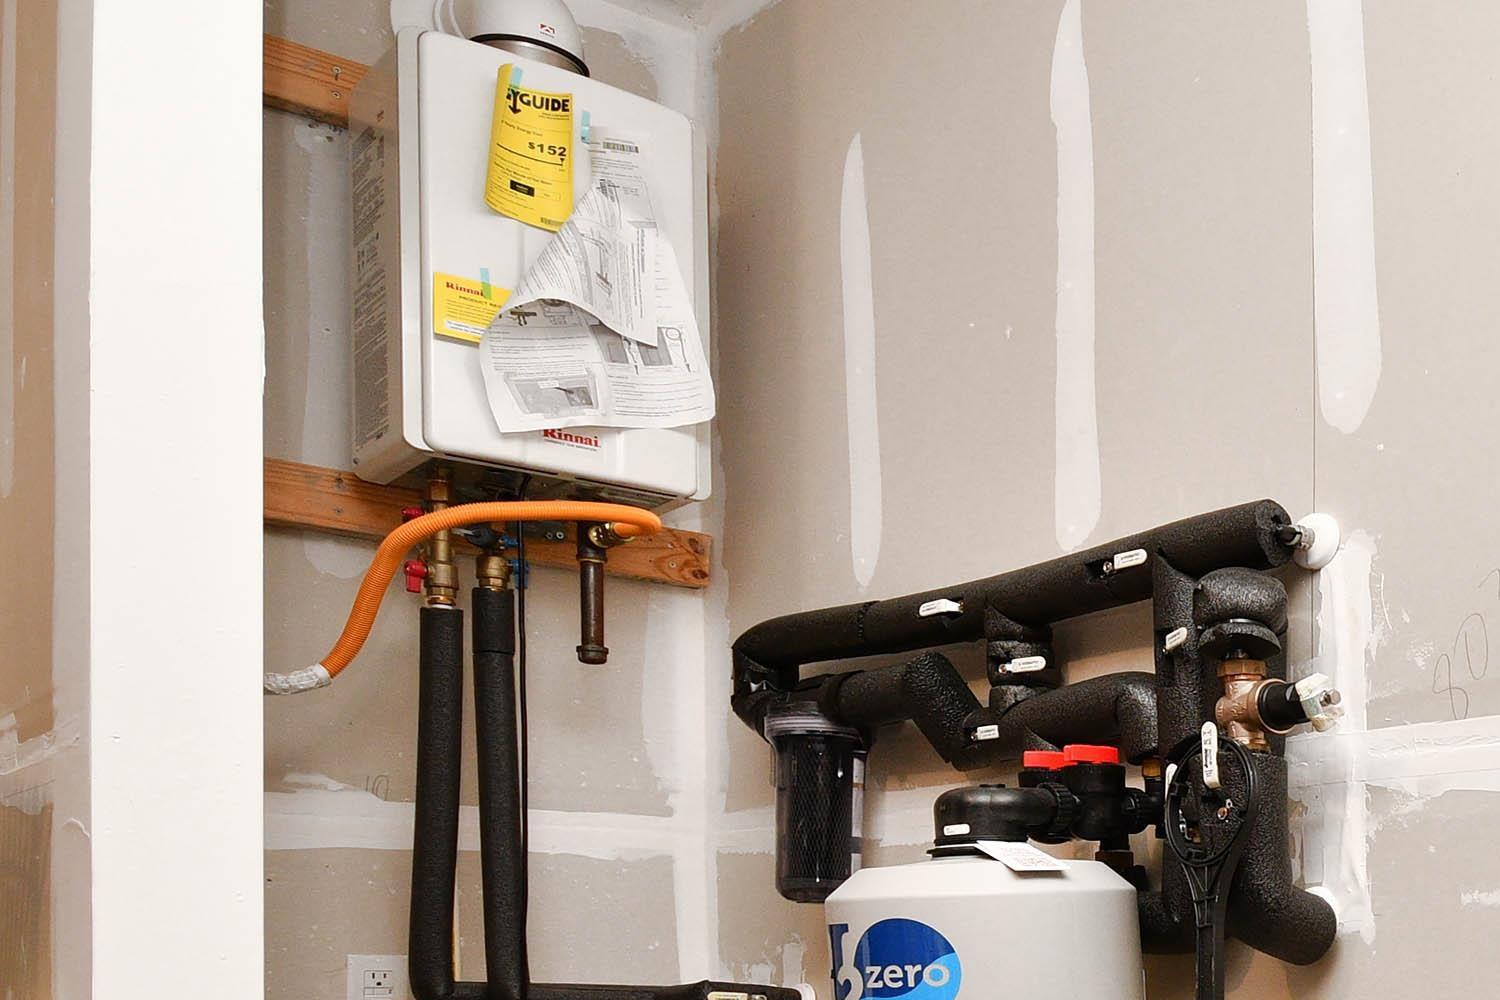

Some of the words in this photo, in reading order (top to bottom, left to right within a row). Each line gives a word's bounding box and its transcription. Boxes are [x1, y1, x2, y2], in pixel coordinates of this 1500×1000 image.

[528, 141, 567, 157] $152
[543, 428, 600, 448] Rinnai
[865, 962, 951, 989] zero
